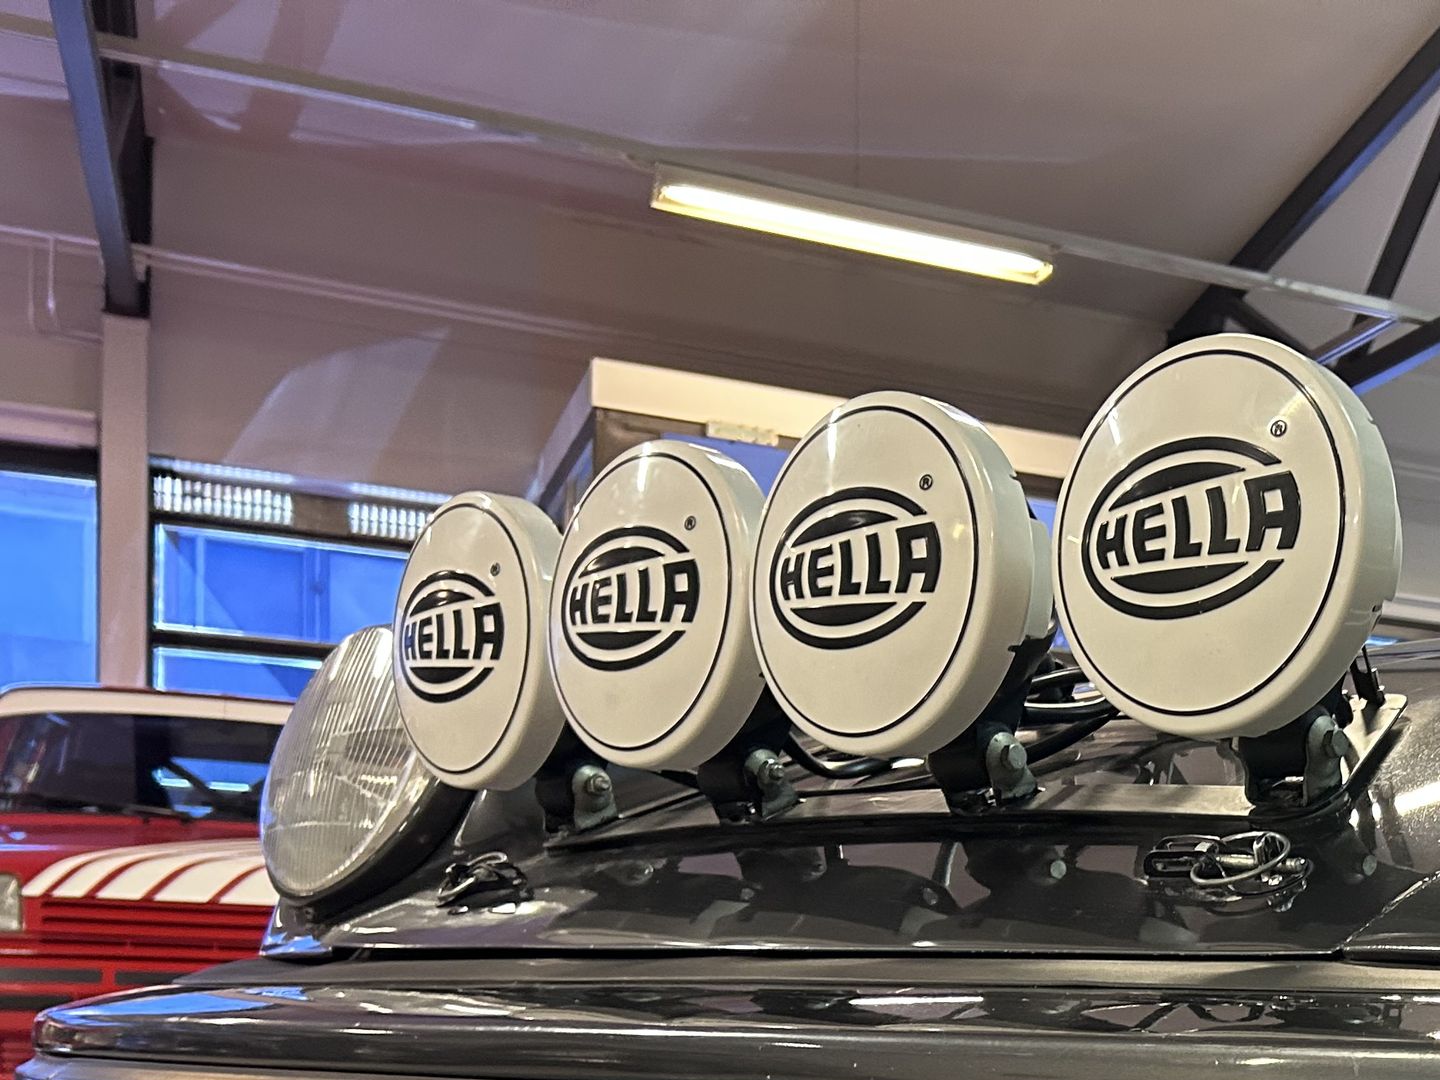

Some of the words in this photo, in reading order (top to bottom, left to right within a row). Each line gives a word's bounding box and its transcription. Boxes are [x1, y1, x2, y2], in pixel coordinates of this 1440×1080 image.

[1099, 470, 1300, 570] HELLA
[569, 559, 699, 625] HELLA
[780, 521, 939, 600] HELLA
[404, 602, 503, 661] HELLA
